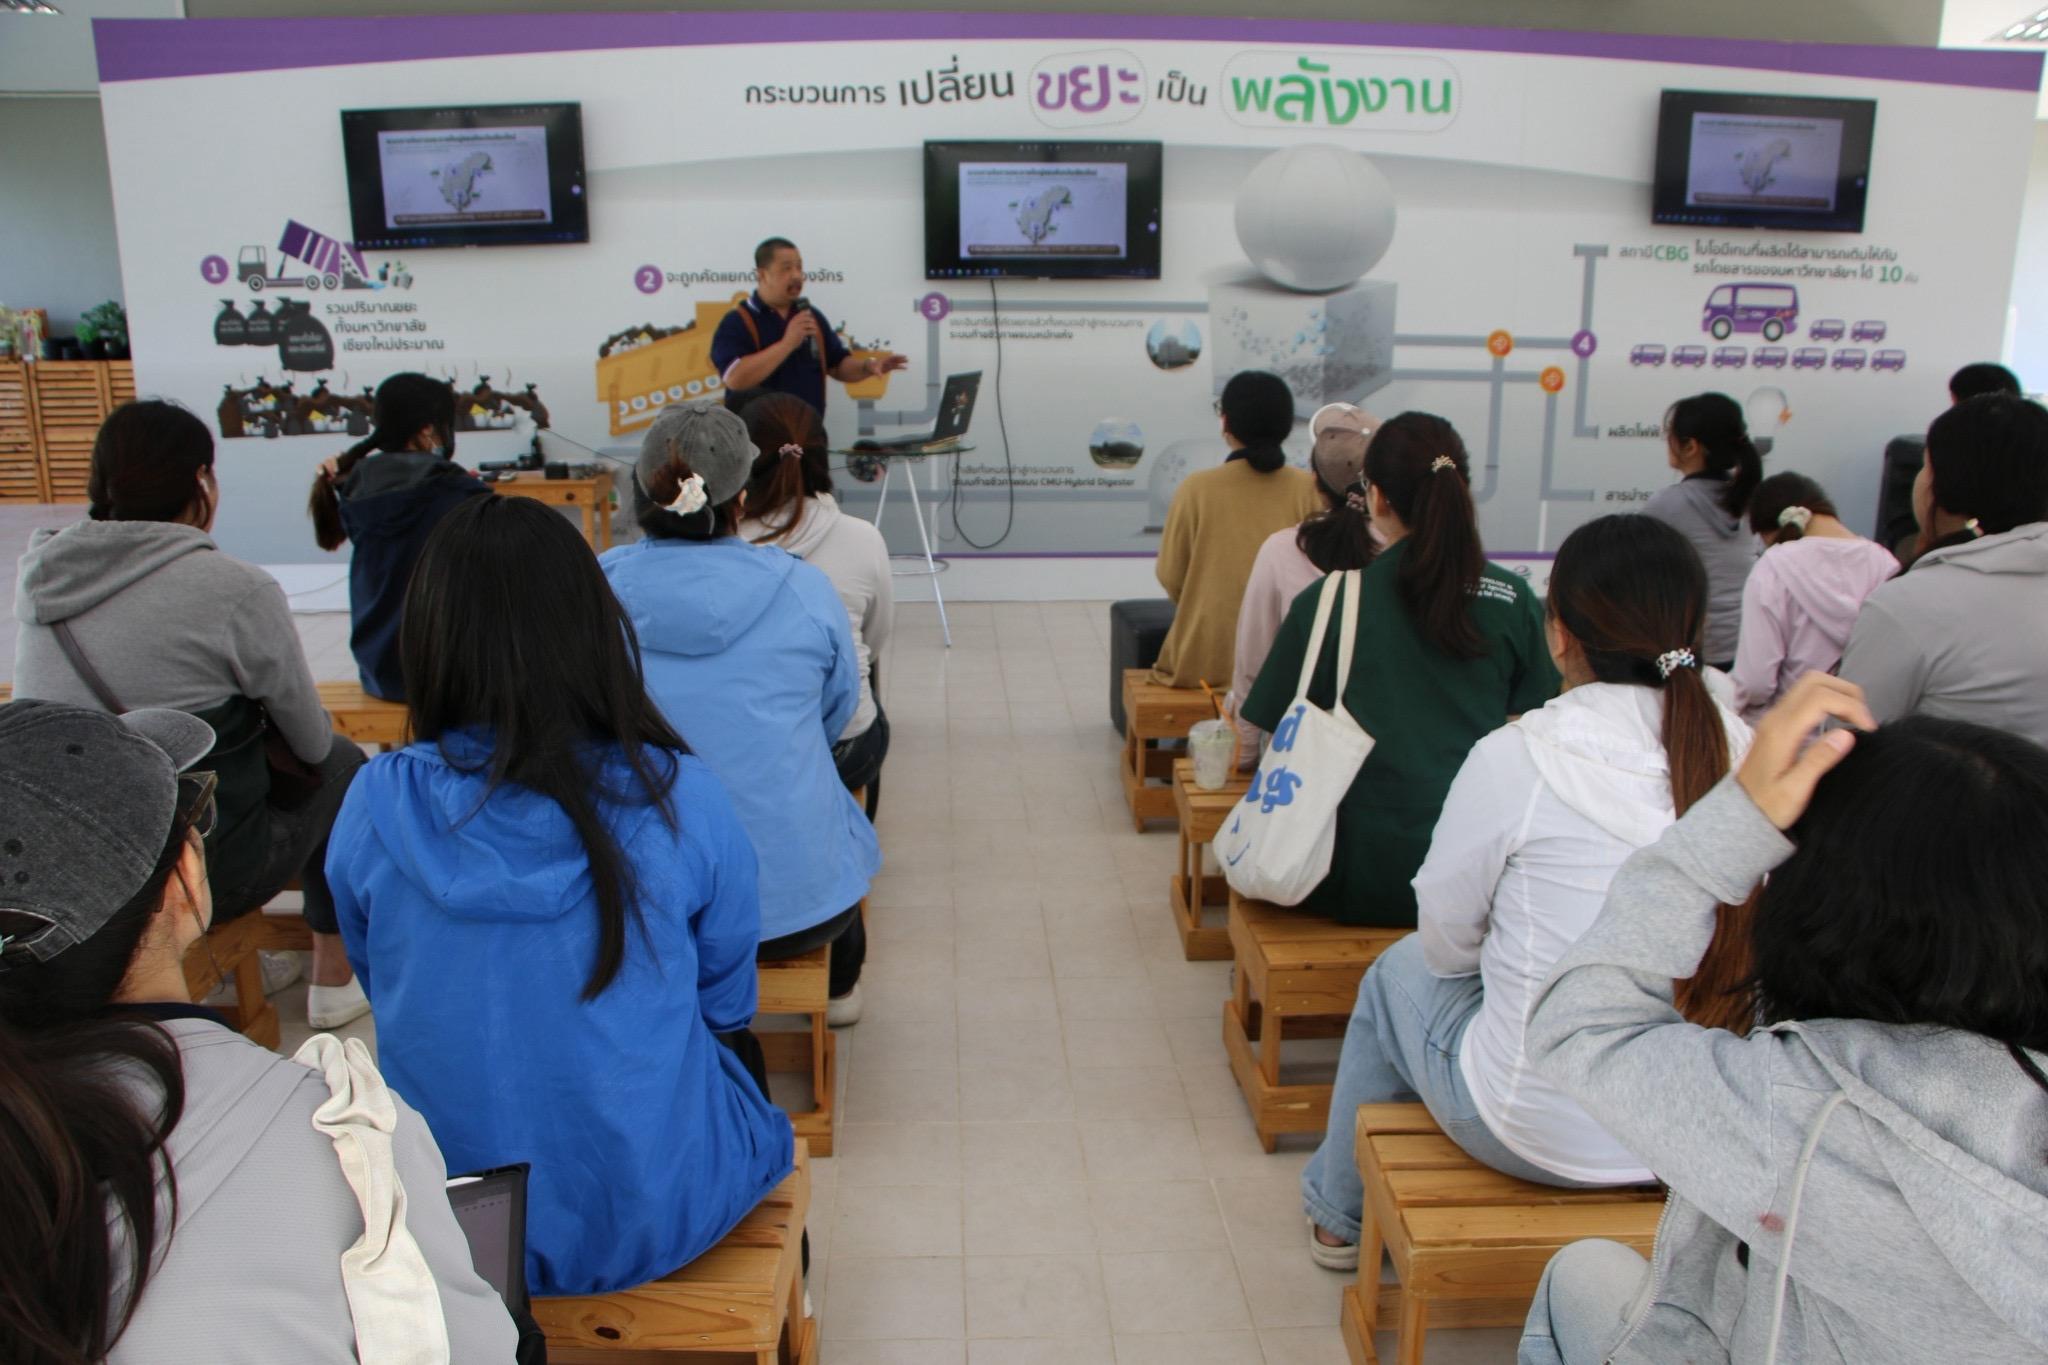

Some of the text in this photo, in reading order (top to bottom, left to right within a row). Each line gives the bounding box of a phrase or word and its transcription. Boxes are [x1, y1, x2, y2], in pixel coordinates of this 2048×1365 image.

[745, 54, 1452, 126] กระบวนการ เปลี่ยน ขยะ เป็น พลังงาน
[1654, 244, 1689, 261] CBG
[1879, 265, 1903, 282] 10
[326, 300, 418, 314] รวมปริมาณขยะ
[335, 316, 427, 333] ทั้งมหาวิทยาลัย
[1608, 422, 1661, 437] ผลิตไฟฟ้
[1097, 478, 1136, 488] Digester
